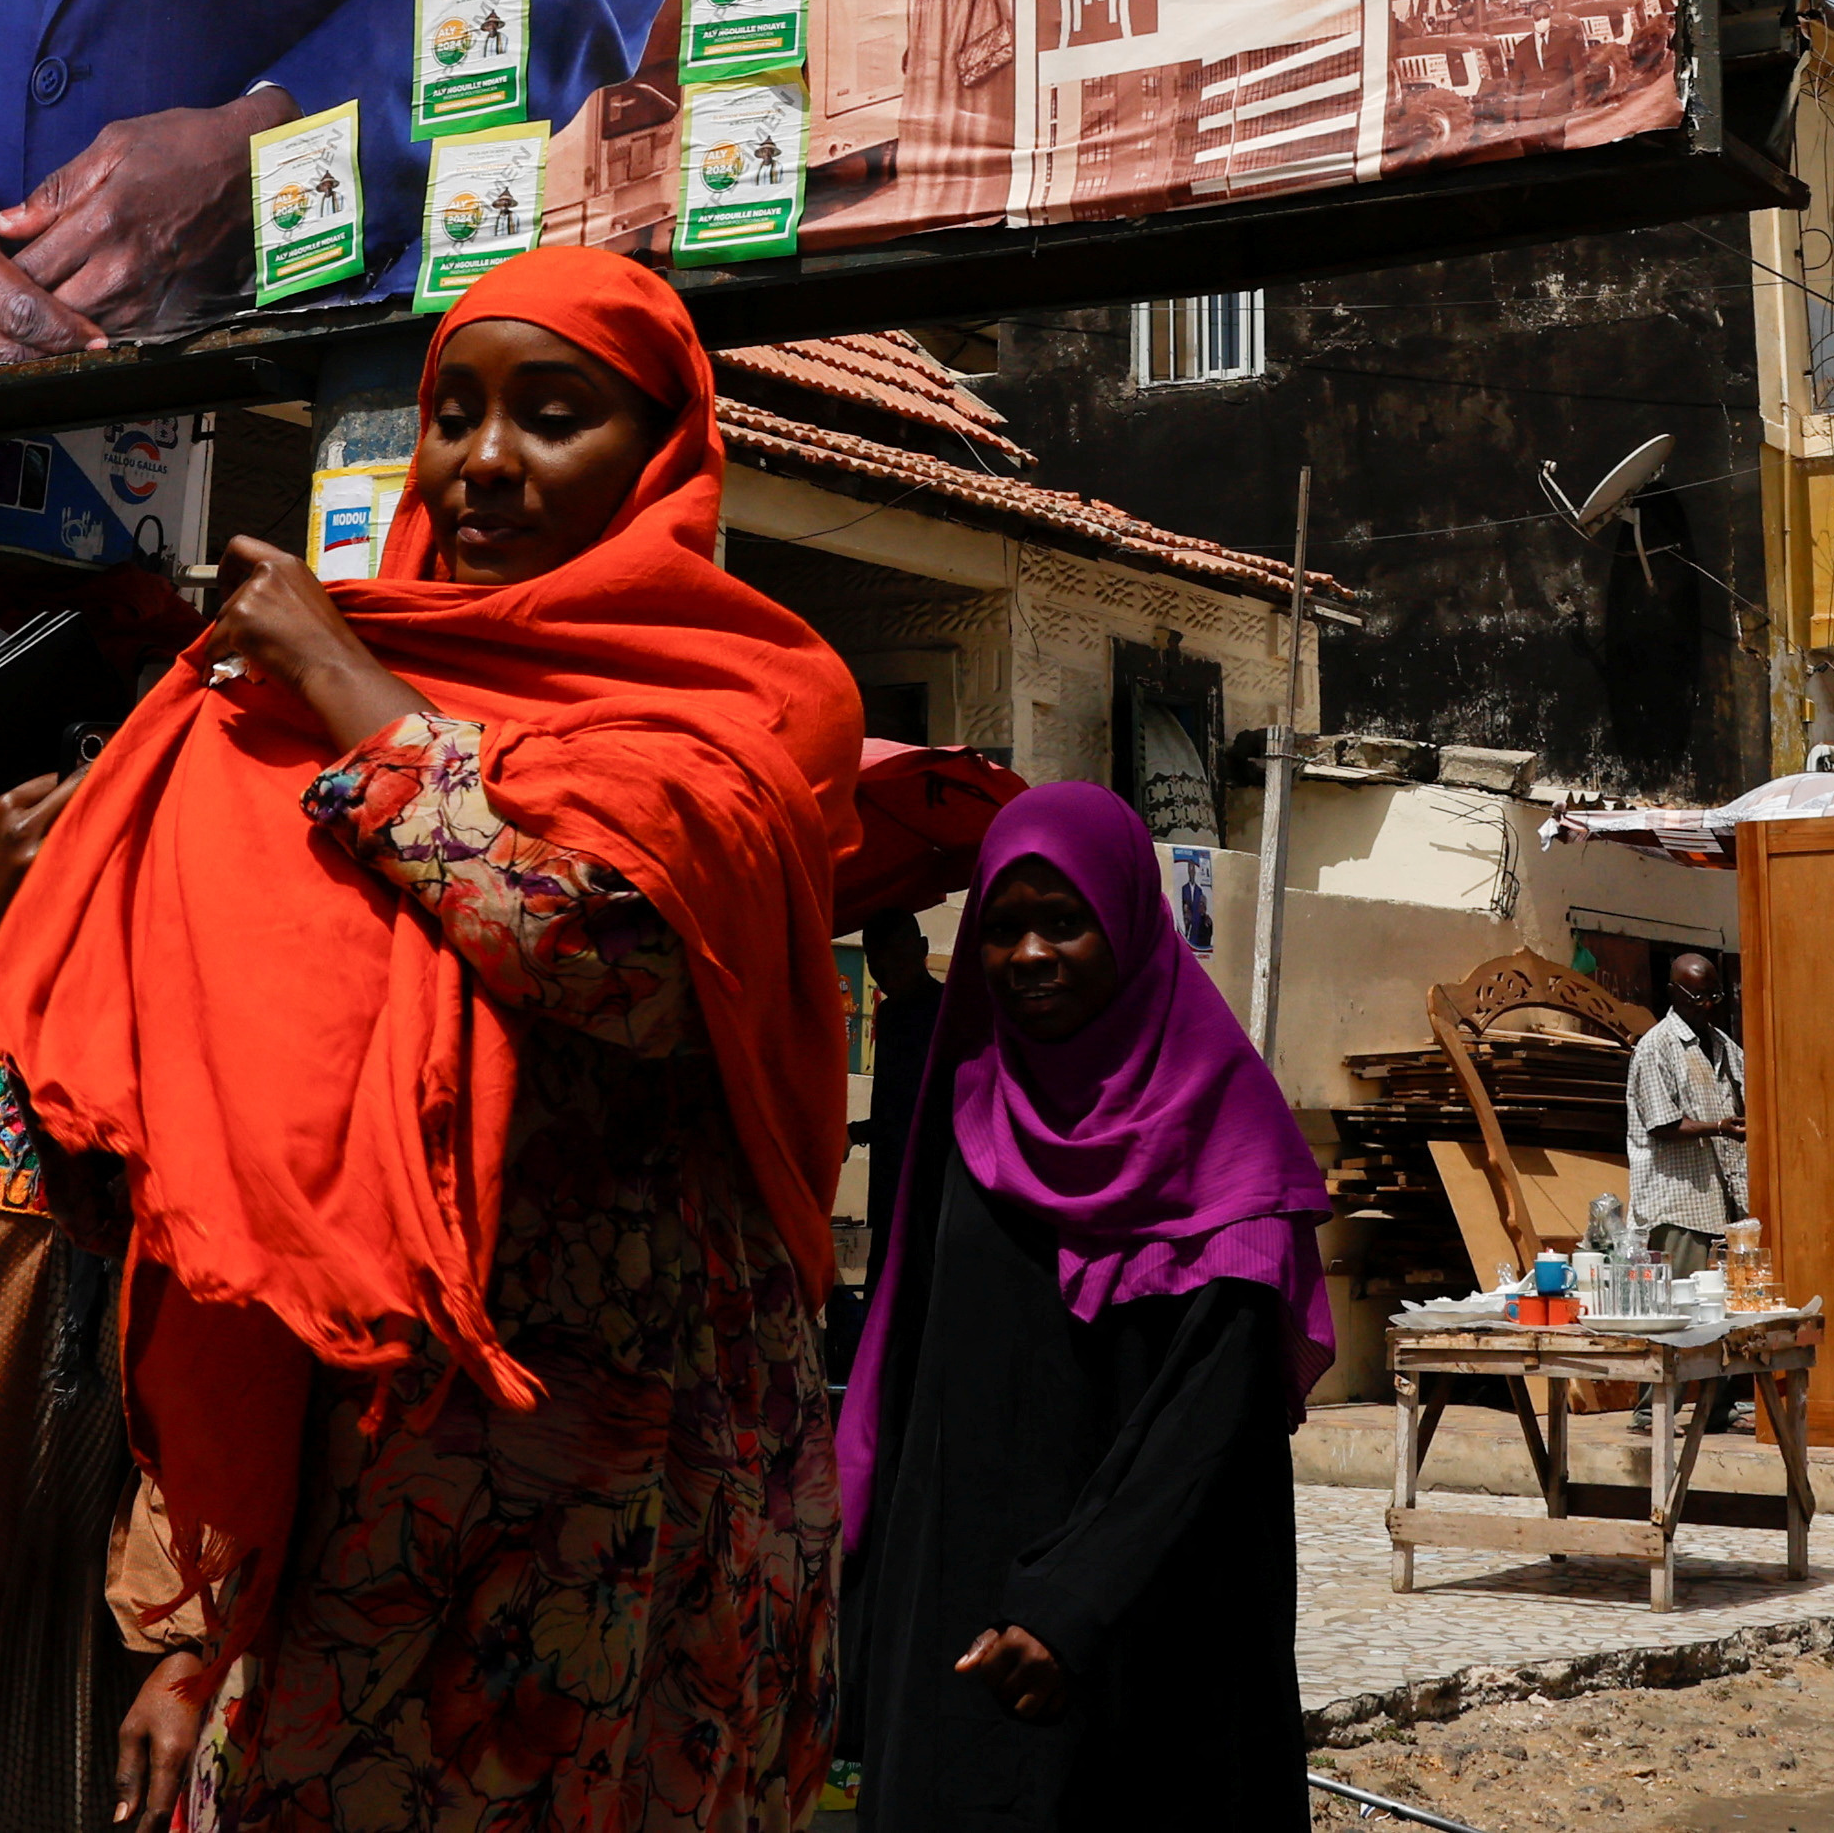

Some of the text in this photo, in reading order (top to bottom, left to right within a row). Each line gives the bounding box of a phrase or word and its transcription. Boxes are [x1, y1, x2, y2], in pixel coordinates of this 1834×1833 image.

[438, 26, 456, 38] ALY
[703, 30, 717, 39] ALY
[432, 87, 447, 97] ALY
[707, 149, 728, 160] ALY
[276, 192, 292, 204] ALY
[450, 201, 467, 209] ALY
[698, 214, 712, 223] ALY
[275, 250, 288, 262] ALY
[440, 261, 454, 271] ALY
[490, 256, 511, 266] NDIA
[104, 453, 136, 468] FALLOU
[136, 460, 168, 474] GALLAS
[332, 513, 366, 527] MODOU
